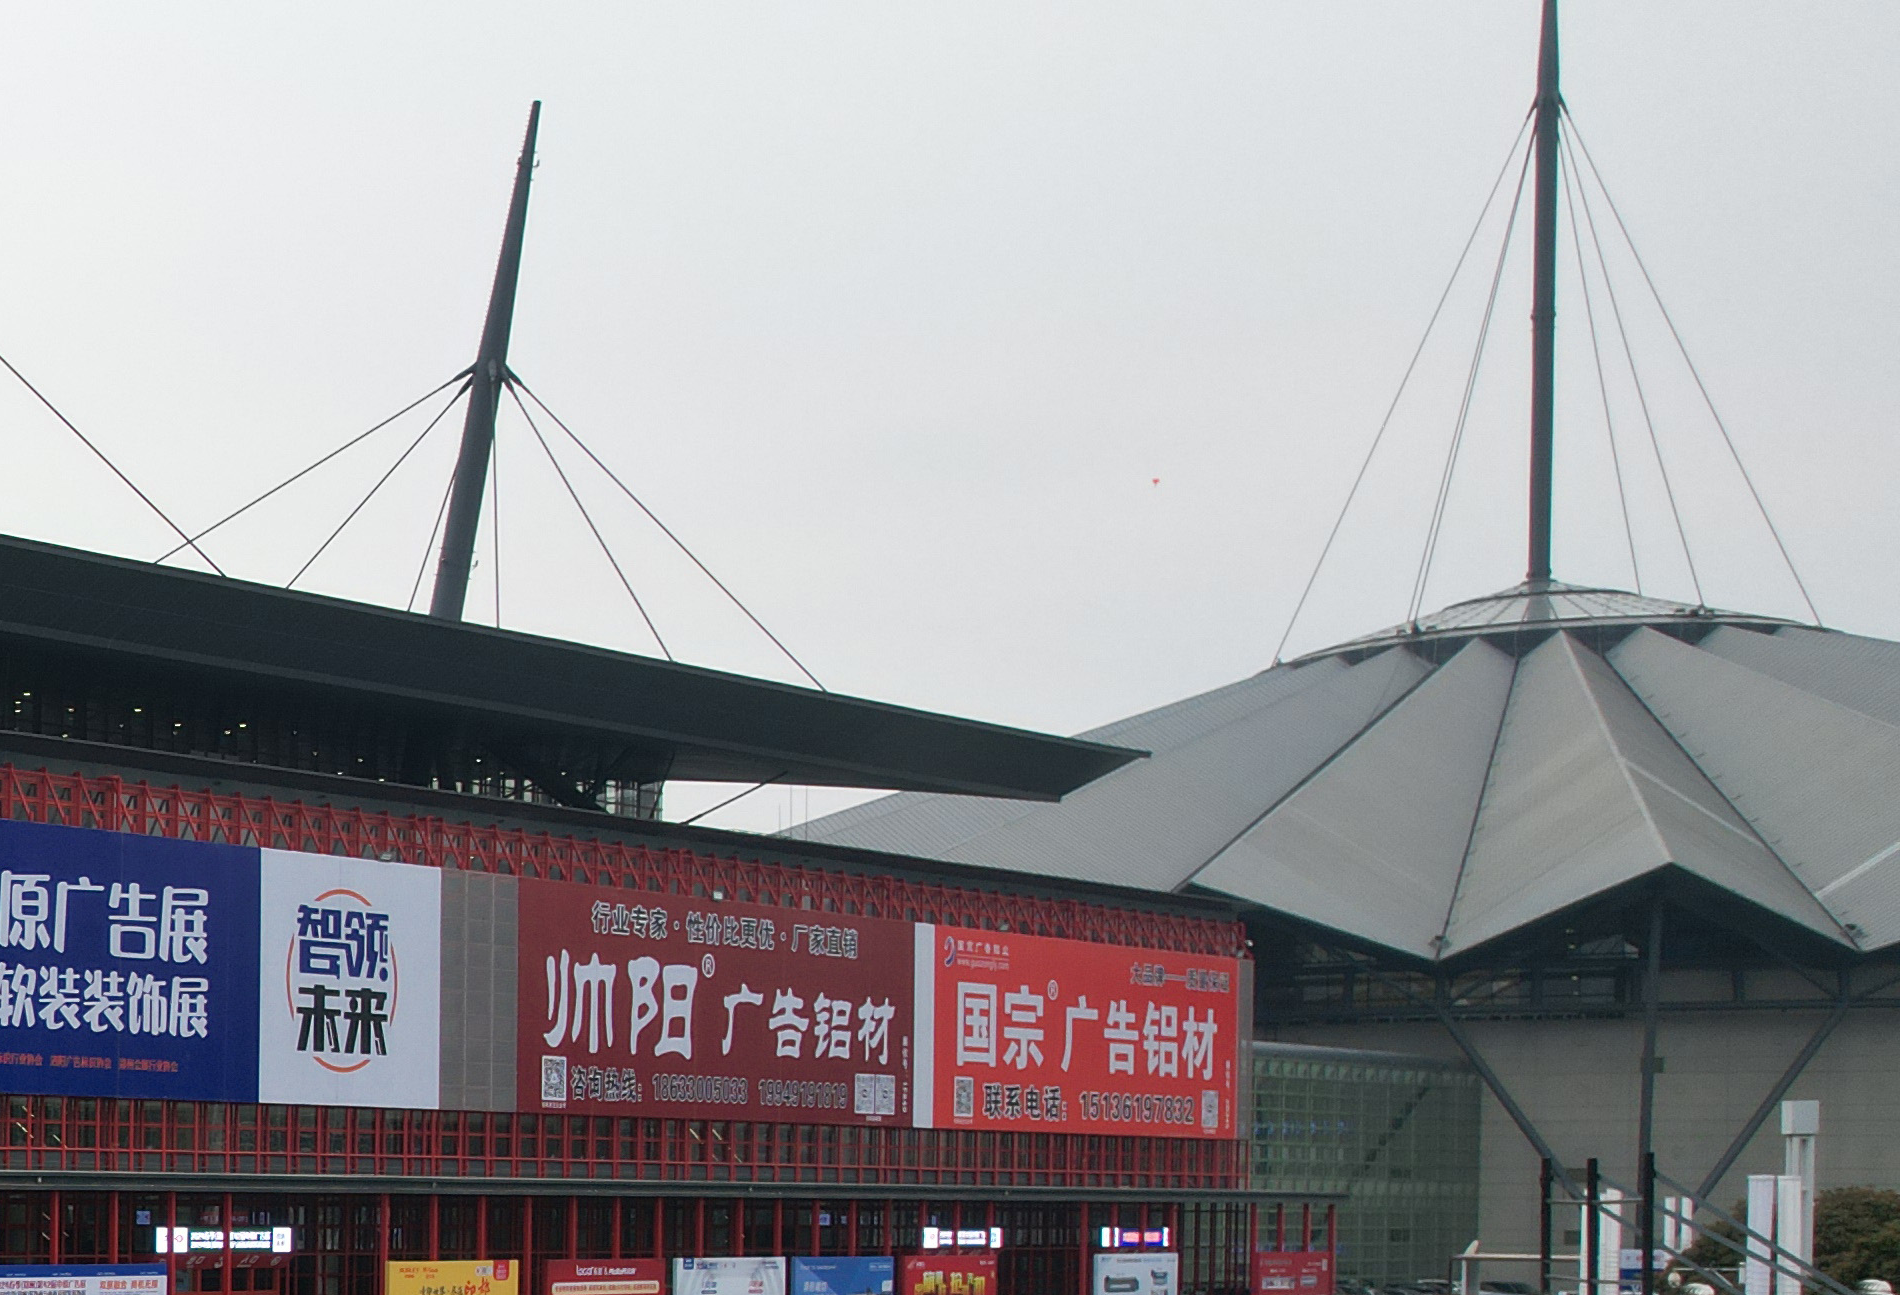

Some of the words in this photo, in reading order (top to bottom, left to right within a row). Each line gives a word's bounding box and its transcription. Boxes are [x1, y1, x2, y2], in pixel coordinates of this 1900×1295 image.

[296, 984, 388, 1056] 未来
[722, 983, 896, 1065] 广告铝材
[956, 981, 1044, 1070] 国宗
[1061, 996, 1219, 1081] 广告铝材
[1079, 1092, 1195, 1125] 15136197832
